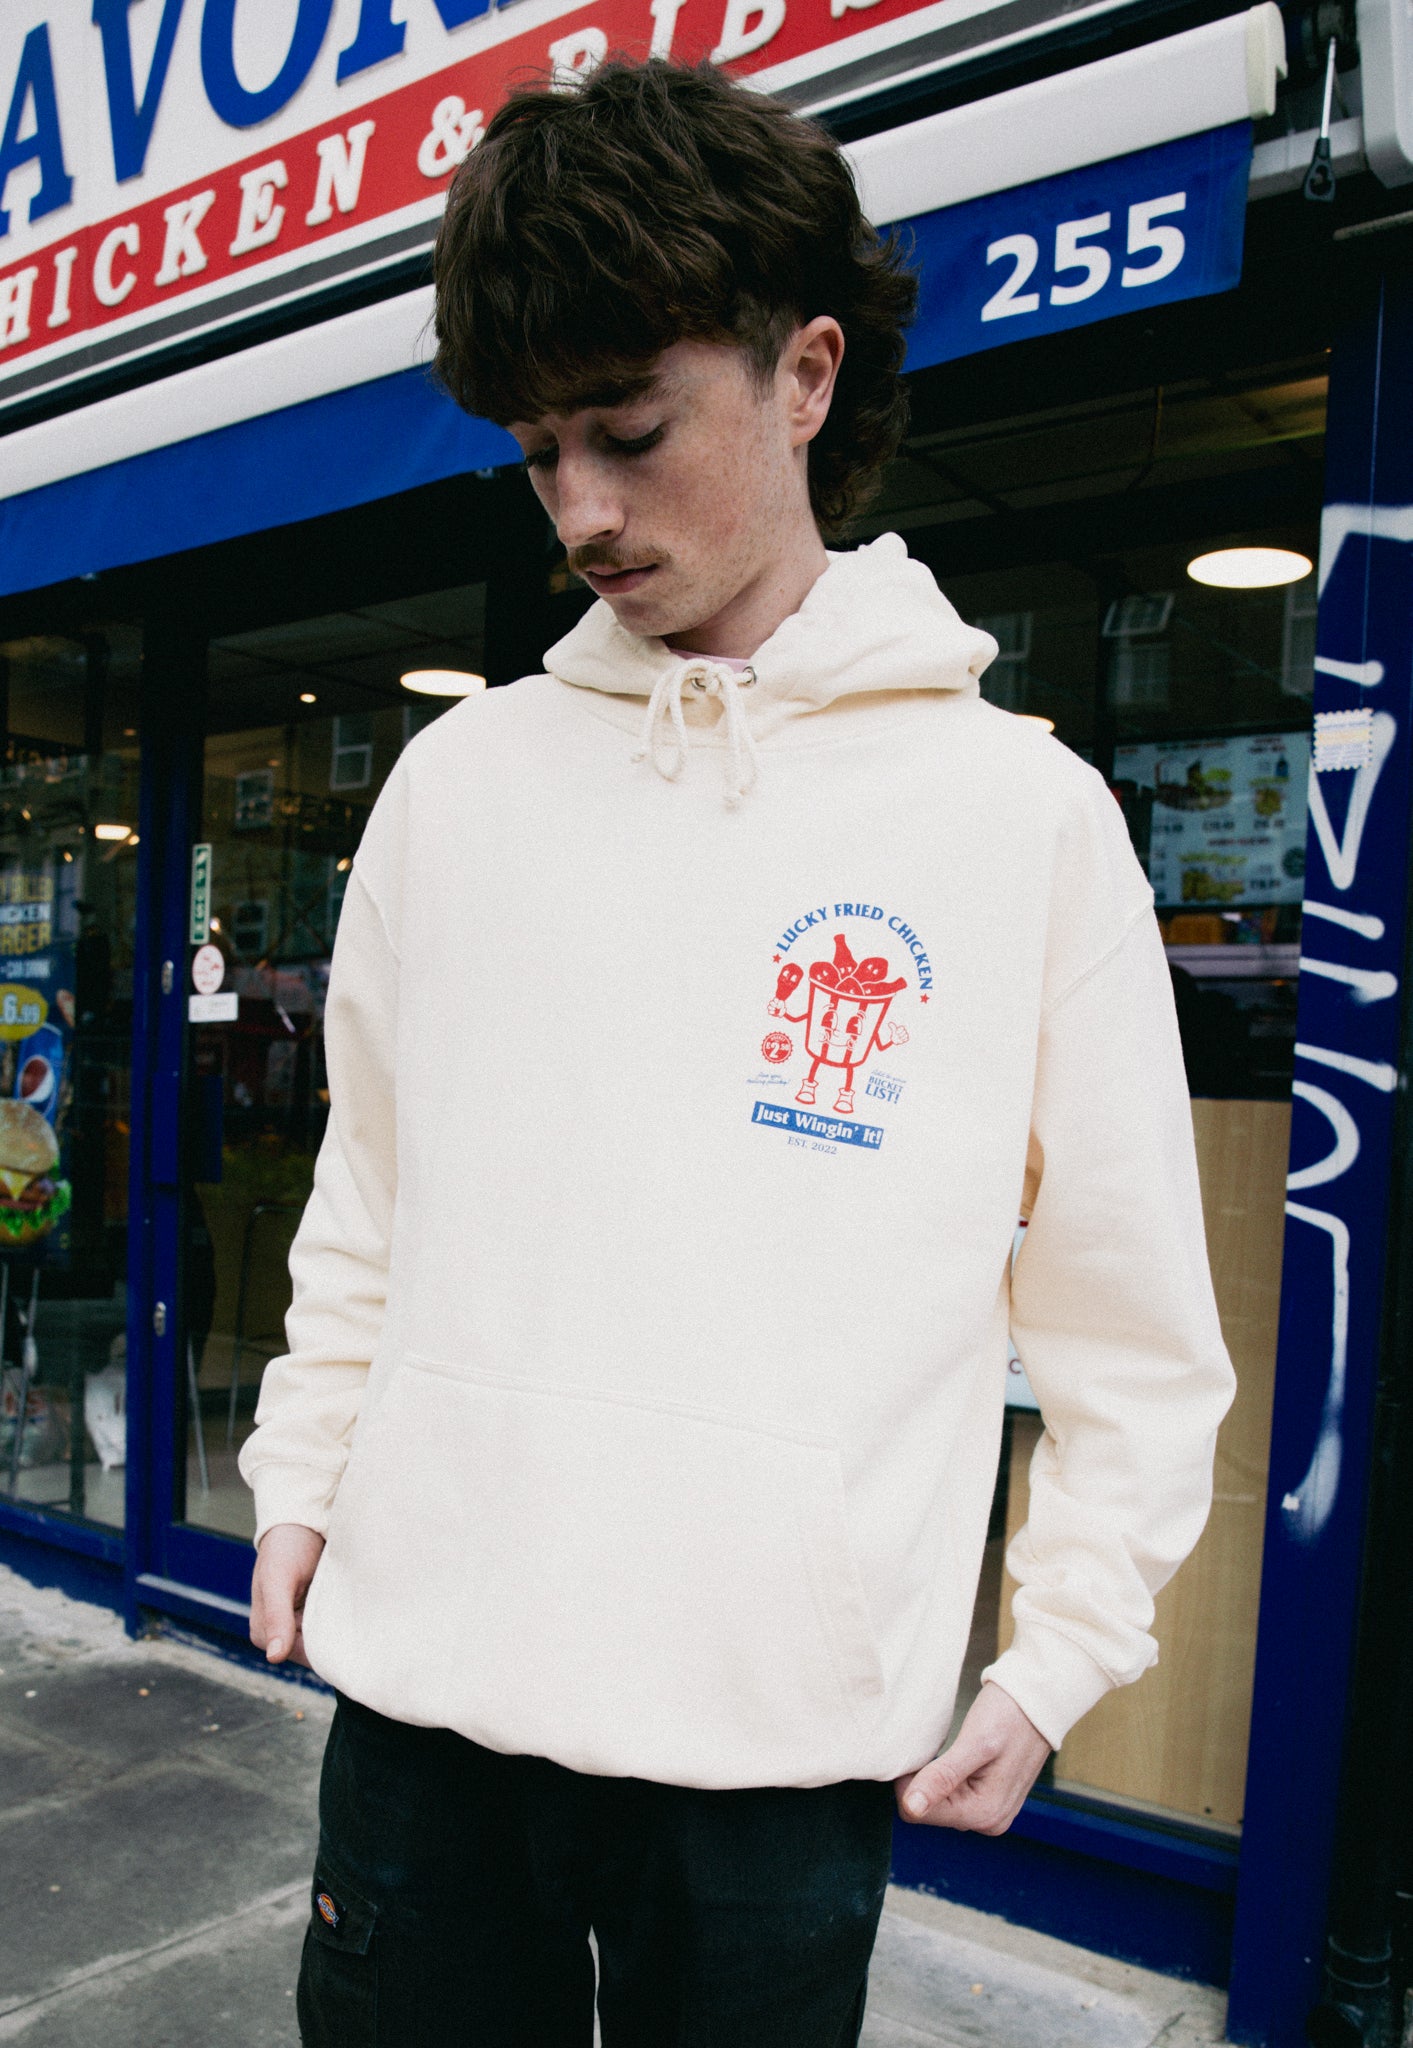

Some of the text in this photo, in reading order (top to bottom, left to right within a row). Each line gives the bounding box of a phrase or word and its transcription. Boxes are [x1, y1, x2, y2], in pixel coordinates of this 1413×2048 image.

[417, 95, 483, 179] &
[981, 191, 1187, 322] 255
[776, 903, 933, 990] LUCKY FRIED CHICKEN
[0, 993, 40, 1025] 6.99
[865, 1084, 900, 1104] LIST!
[869, 1076, 903, 1093] BUCKET
[756, 1104, 883, 1145] Just Wingin' It!
[787, 1136, 837, 1155] EST. 2022
